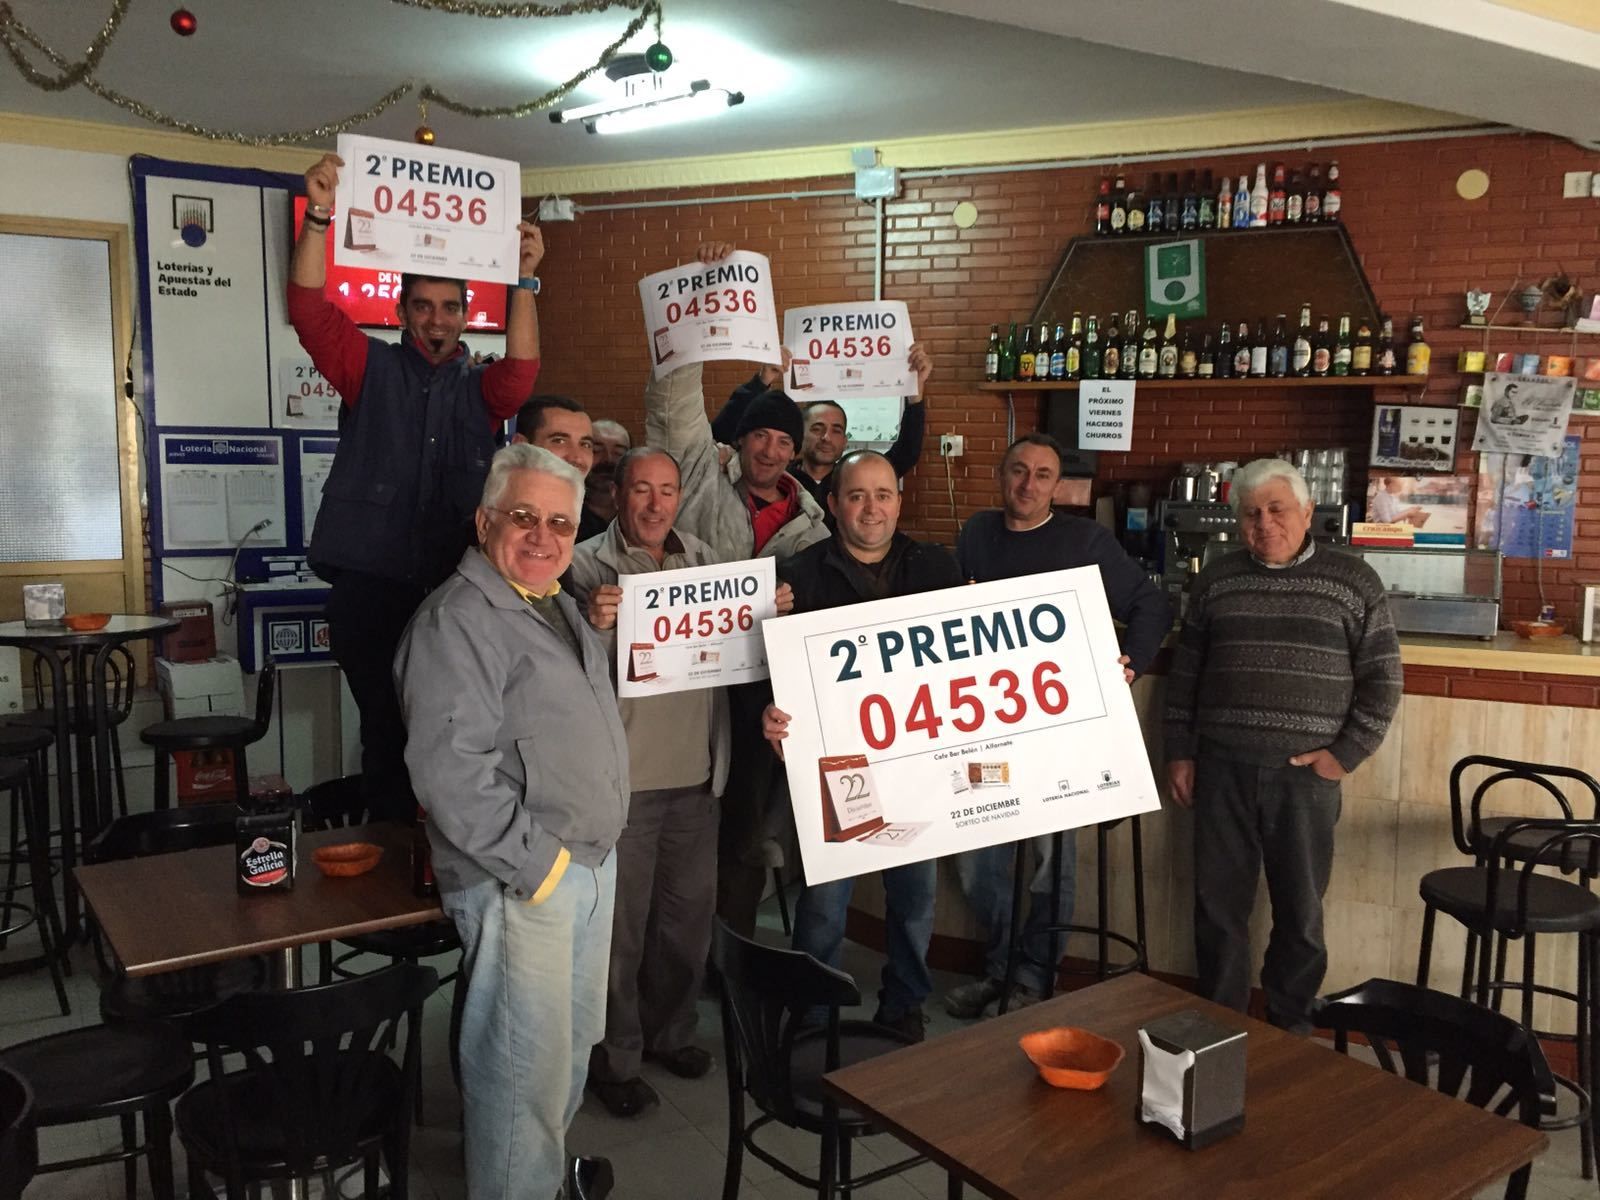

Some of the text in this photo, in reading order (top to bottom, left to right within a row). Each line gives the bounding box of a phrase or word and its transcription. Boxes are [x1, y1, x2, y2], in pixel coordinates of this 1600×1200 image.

[392, 157, 495, 191] PREMIO
[374, 185, 487, 226] 04536
[158, 273, 231, 287] Apuestas del
[207, 266, 213, 276] y
[378, 272, 391, 283] DE
[677, 264, 759, 294] PREMIO
[158, 286, 197, 297] Estado
[666, 288, 757, 324] 04536
[820, 312, 896, 332] PREMIO
[808, 335, 891, 360] 04536
[1088, 397, 1124, 405] PRÓXIMO
[229, 445, 267, 453] Nacional
[669, 576, 759, 607] PREMIO
[654, 604, 753, 642] 04536
[830, 603, 1066, 682] 2º PREMIO
[859, 660, 1069, 751] 04536
[949, 750, 960, 758] Bar
[961, 746, 978, 755] Belén
[839, 773, 870, 802] 22
[1064, 788, 1089, 798] NACIONAL
[950, 797, 1020, 819] 22 DE DICIEMBRE
[955, 809, 1020, 829] SORTEO DE NAVIDAD
[246, 851, 284, 867] Estrella
[250, 860, 285, 875] Galicia
